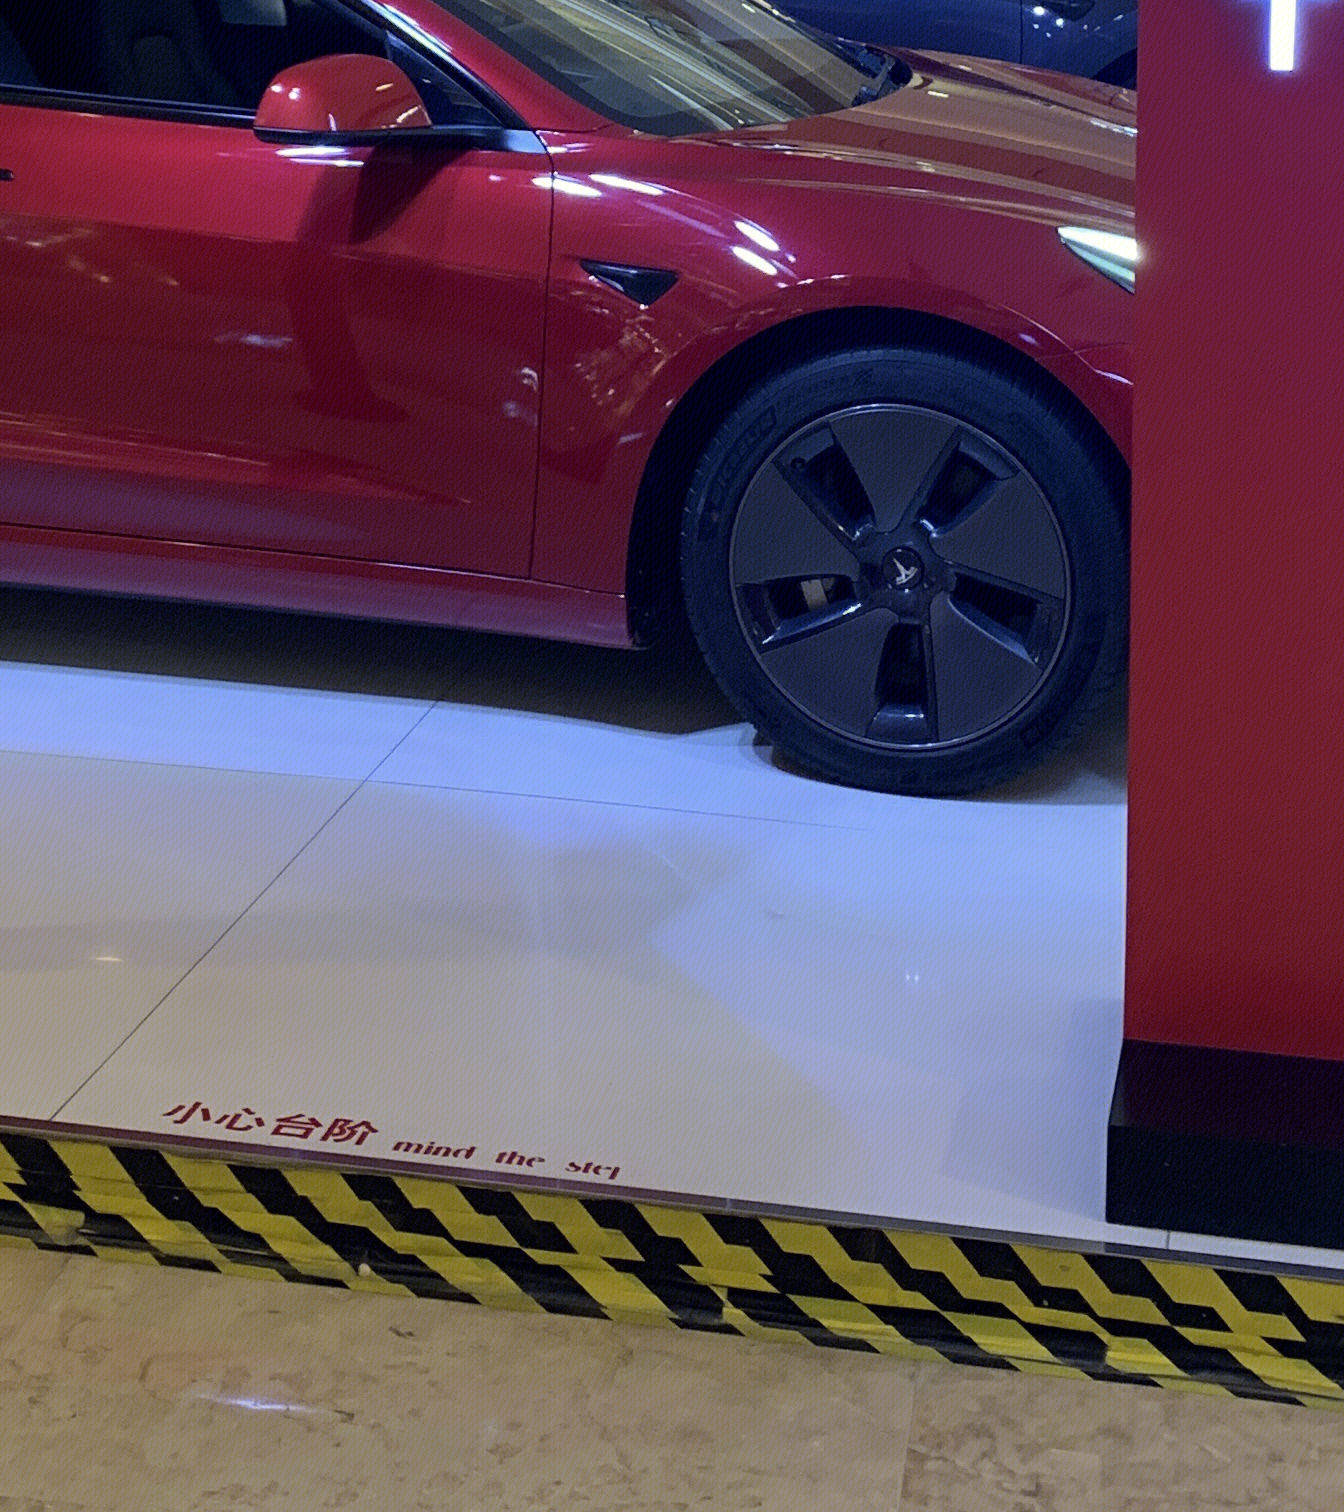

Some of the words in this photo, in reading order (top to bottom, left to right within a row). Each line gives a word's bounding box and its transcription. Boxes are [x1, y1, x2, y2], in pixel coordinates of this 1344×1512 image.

[162, 1101, 379, 1146] 小心台阶
[392, 1140, 477, 1160] mind
[494, 1150, 546, 1168] the
